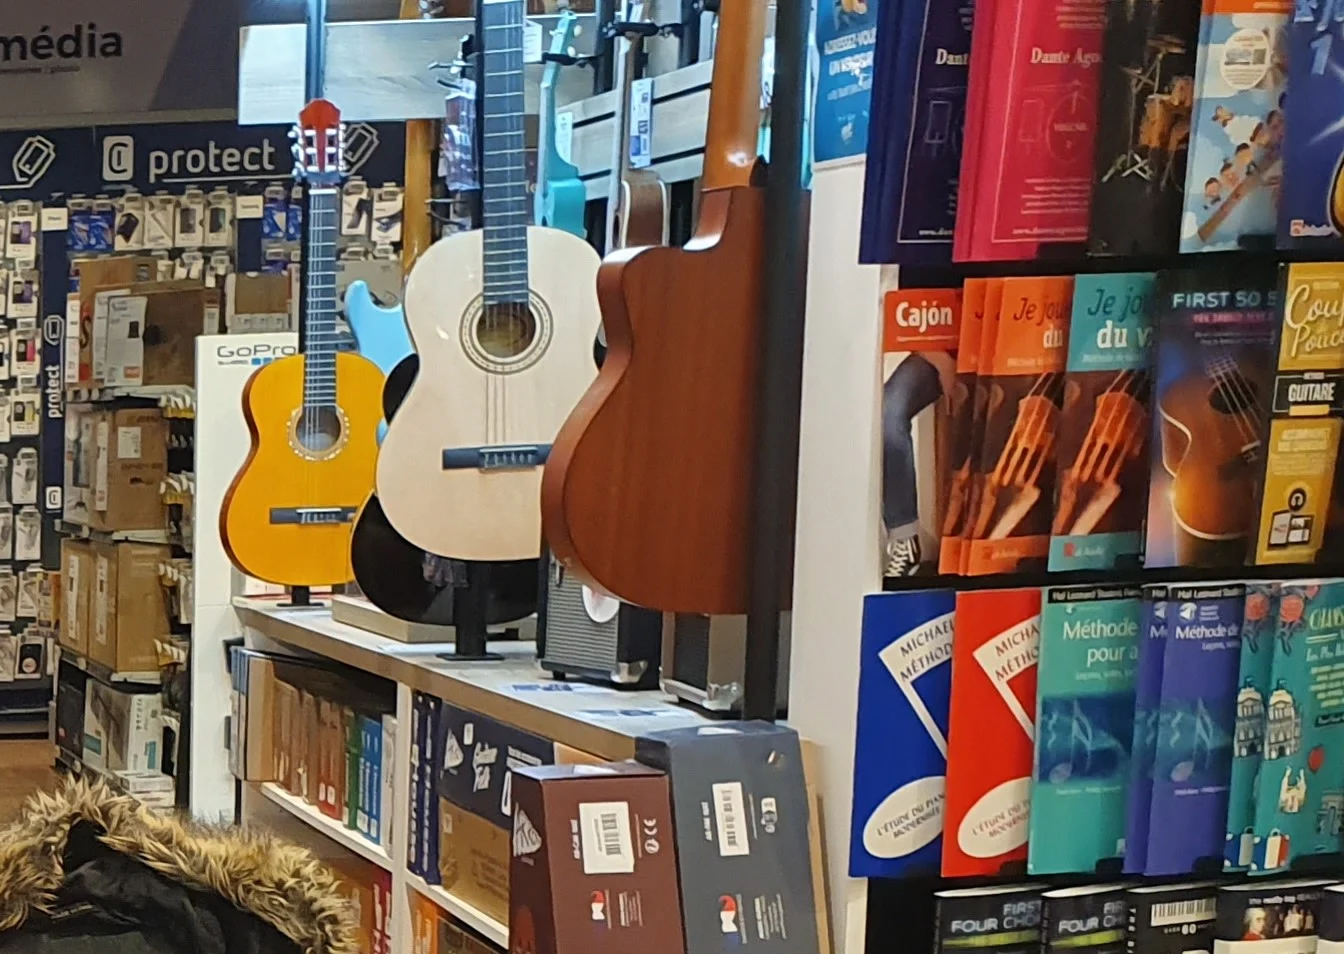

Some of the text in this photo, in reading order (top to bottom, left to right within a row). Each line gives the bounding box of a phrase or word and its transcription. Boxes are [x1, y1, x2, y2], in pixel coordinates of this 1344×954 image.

[1031, 47, 1069, 65] Dante
[149, 137, 275, 177] protect
[1013, 297, 1037, 322] Je
[1087, 288, 1118, 317] Je
[1172, 291, 1230, 308] FIRST
[895, 301, 953, 333] Cajón
[1043, 325, 1064, 349] du
[1096, 319, 1128, 349] du
[217, 344, 296, 358] GoPro
[45, 365, 63, 419] protect
[1288, 382, 1337, 402] GUITARE
[1062, 618, 1141, 641] Méthode
[1175, 622, 1227, 640] Méthode
[1087, 646, 1125, 668] pour
[951, 918, 998, 933] FOUR
[1058, 918, 1099, 933] FOUR
